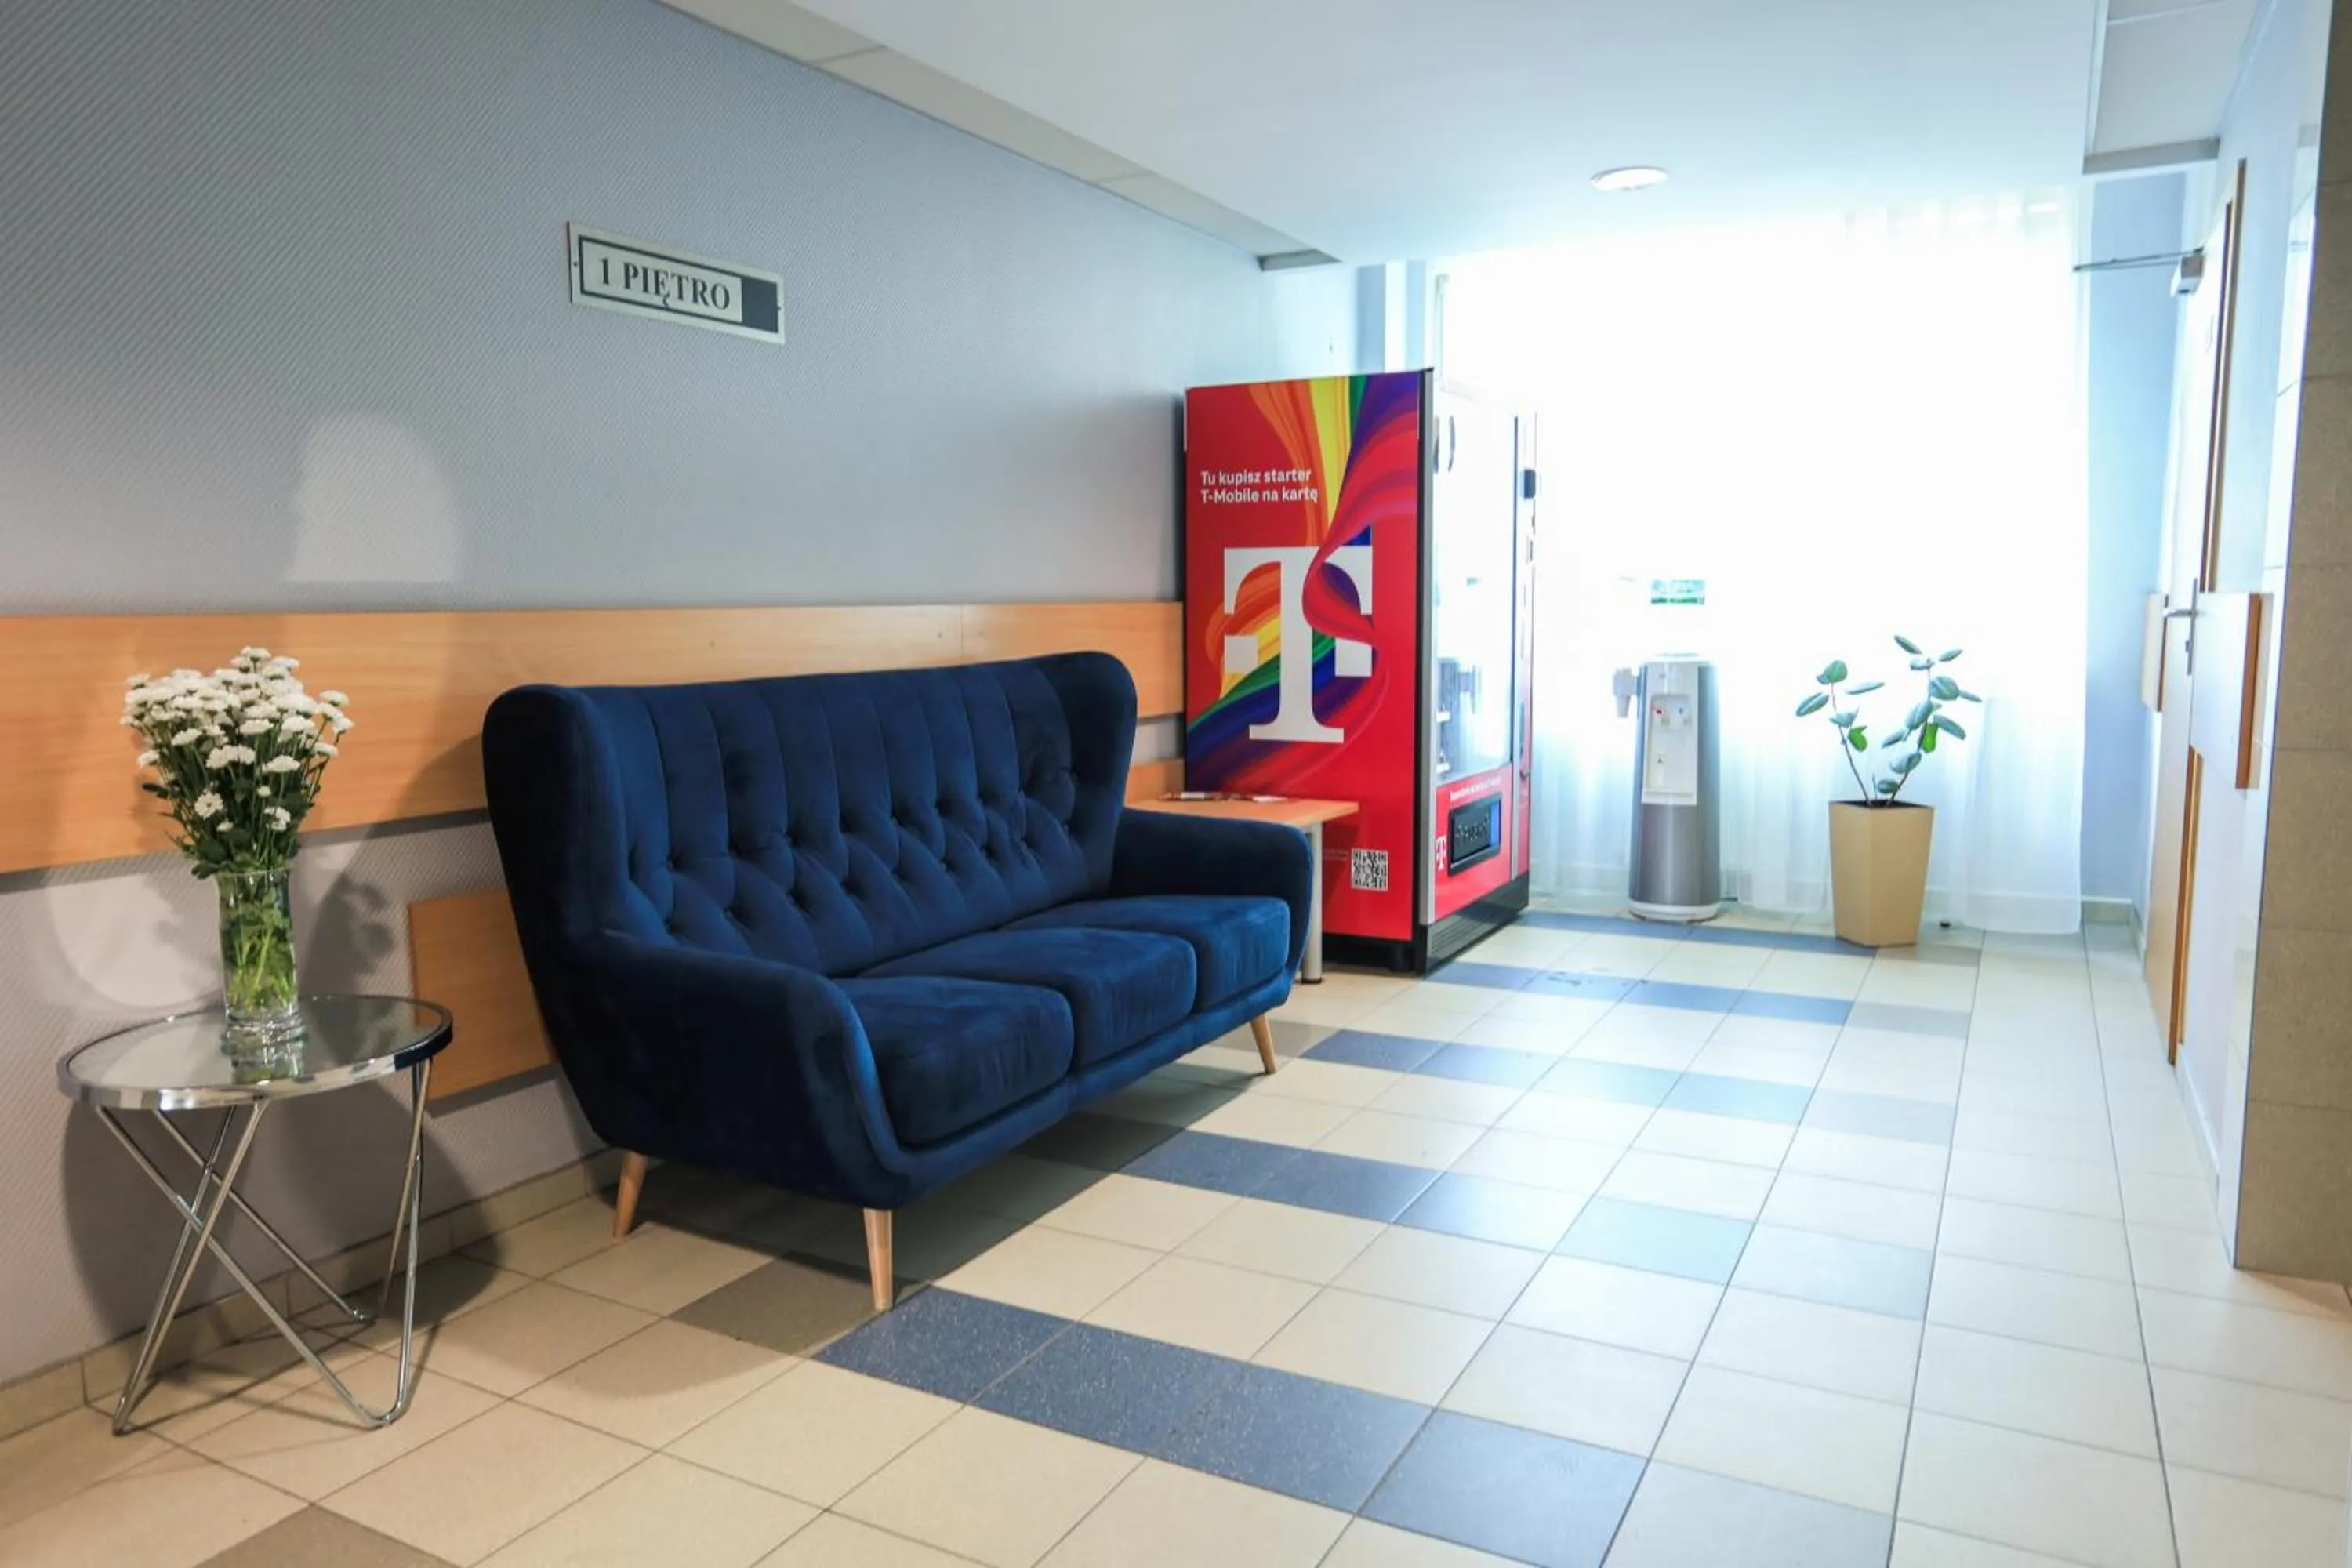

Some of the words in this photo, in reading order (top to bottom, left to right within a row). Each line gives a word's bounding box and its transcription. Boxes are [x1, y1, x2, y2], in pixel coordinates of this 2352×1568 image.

[599, 257, 611, 285] 1
[622, 261, 731, 310] PIĘTRO
[1200, 470, 1216, 485] Tu
[1219, 469, 1261, 487] kupisz
[1264, 468, 1312, 483] starter
[1200, 487, 1259, 503] T-Mobile
[1262, 490, 1279, 502] na
[1282, 485, 1318, 503] kartę
[1224, 545, 1373, 744] T
